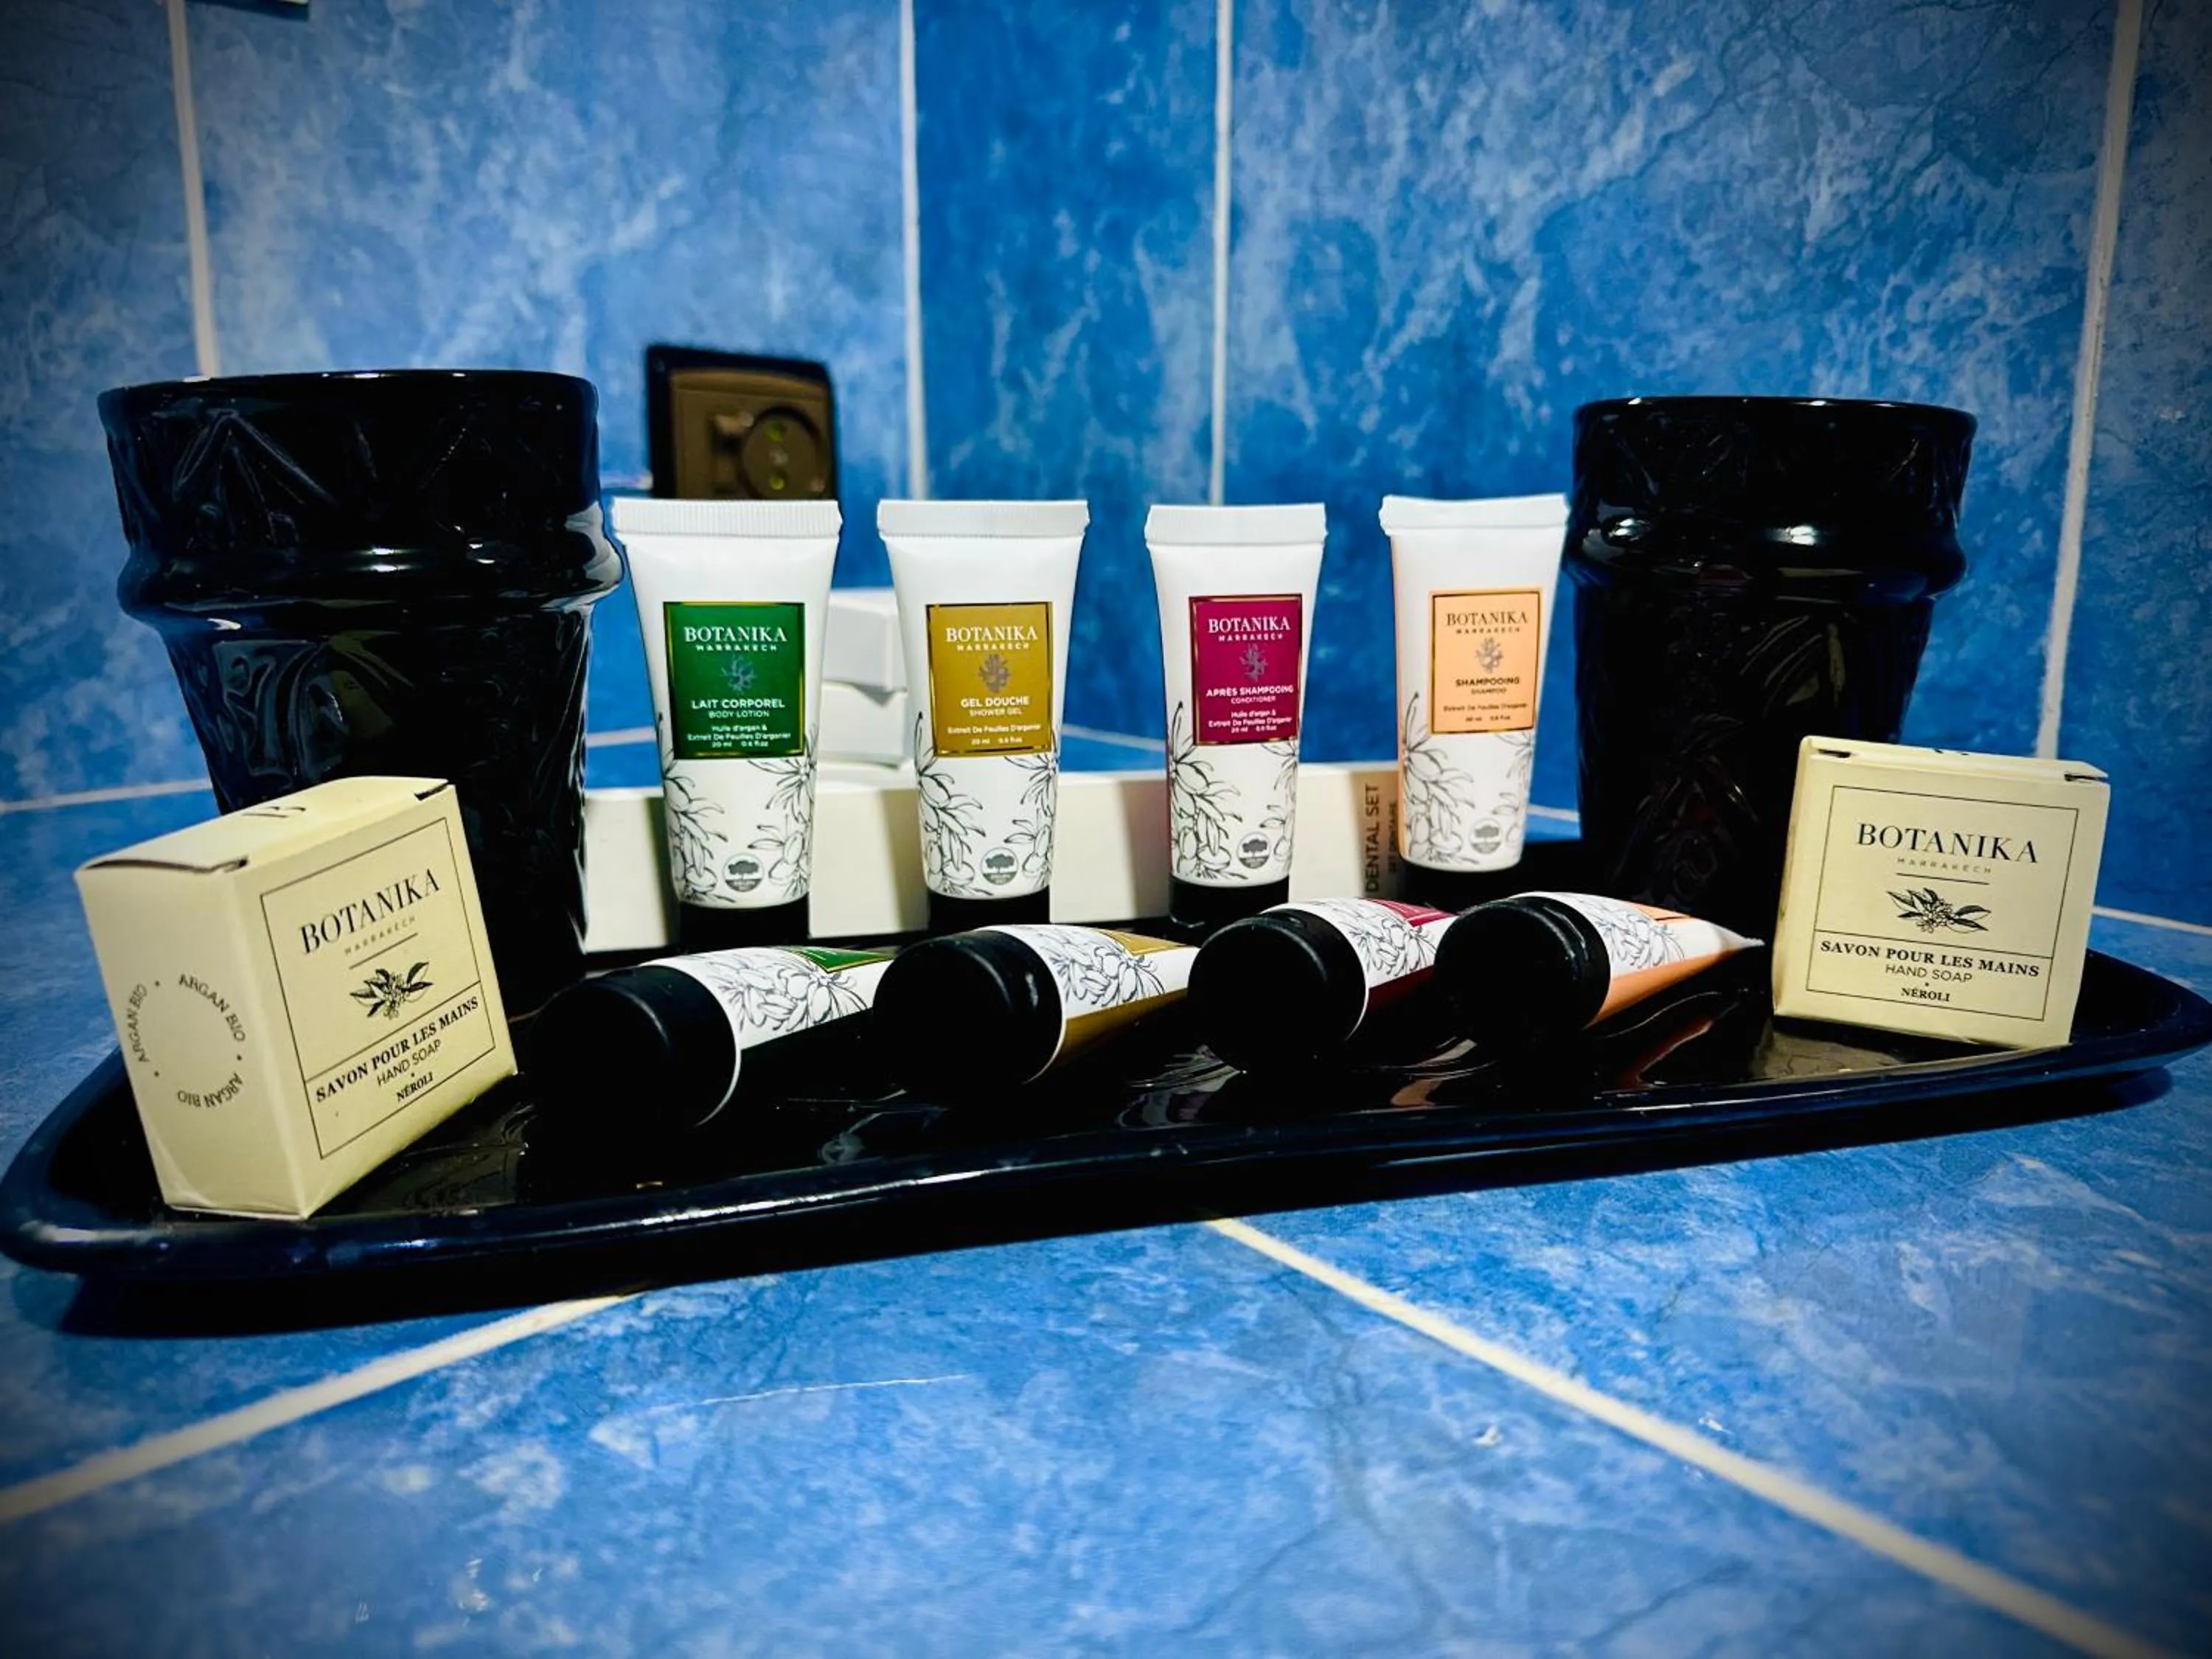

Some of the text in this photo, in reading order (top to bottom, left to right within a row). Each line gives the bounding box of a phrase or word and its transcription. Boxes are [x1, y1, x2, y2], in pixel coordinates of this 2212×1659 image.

[1208, 616, 1290, 633] BOTANIKA
[1446, 611, 1528, 626] BOTANIKA
[684, 626, 787, 642] BOTANIKA
[945, 625, 1038, 642] BOTANIKA
[1219, 633, 1283, 641] MARRAKECH
[957, 643, 1029, 651] MARRAKECH
[1455, 676, 1520, 687] SHAMPOOING
[1206, 685, 1294, 697] APRÈS SHAMPOOING
[692, 698, 785, 709] LAIT CORPOREL
[961, 696, 1029, 709] GEL DOUCHE
[1231, 695, 1276, 704] CONDITIONER
[709, 710, 734, 718] BODY
[970, 709, 1005, 717] SHOWER
[713, 733, 724, 741] De
[973, 726, 983, 734] De
[1366, 784, 1380, 892] DENTAL SET
[1857, 822, 2039, 863] BOTANIKA
[1897, 858, 1991, 873] MARRAKECH
[299, 868, 440, 954] BOTANIKA
[344, 917, 416, 956] MARRAKECH
[1820, 940, 2039, 977] SAVON POUR LES MAINS
[1885, 964, 1973, 983] HAND SOAP
[1901, 986, 1950, 1002] NÉROLI
[178, 974, 246, 1042] ARGAN BIO
[127, 984, 149, 1062] ARGAN BIO
[316, 996, 479, 1103] SAVON POUR LES MAINS
[377, 1039, 442, 1086] HAND SOAP
[177, 1072, 243, 1108] ARGAN BIO
[396, 1071, 434, 1102] NÉROLI
